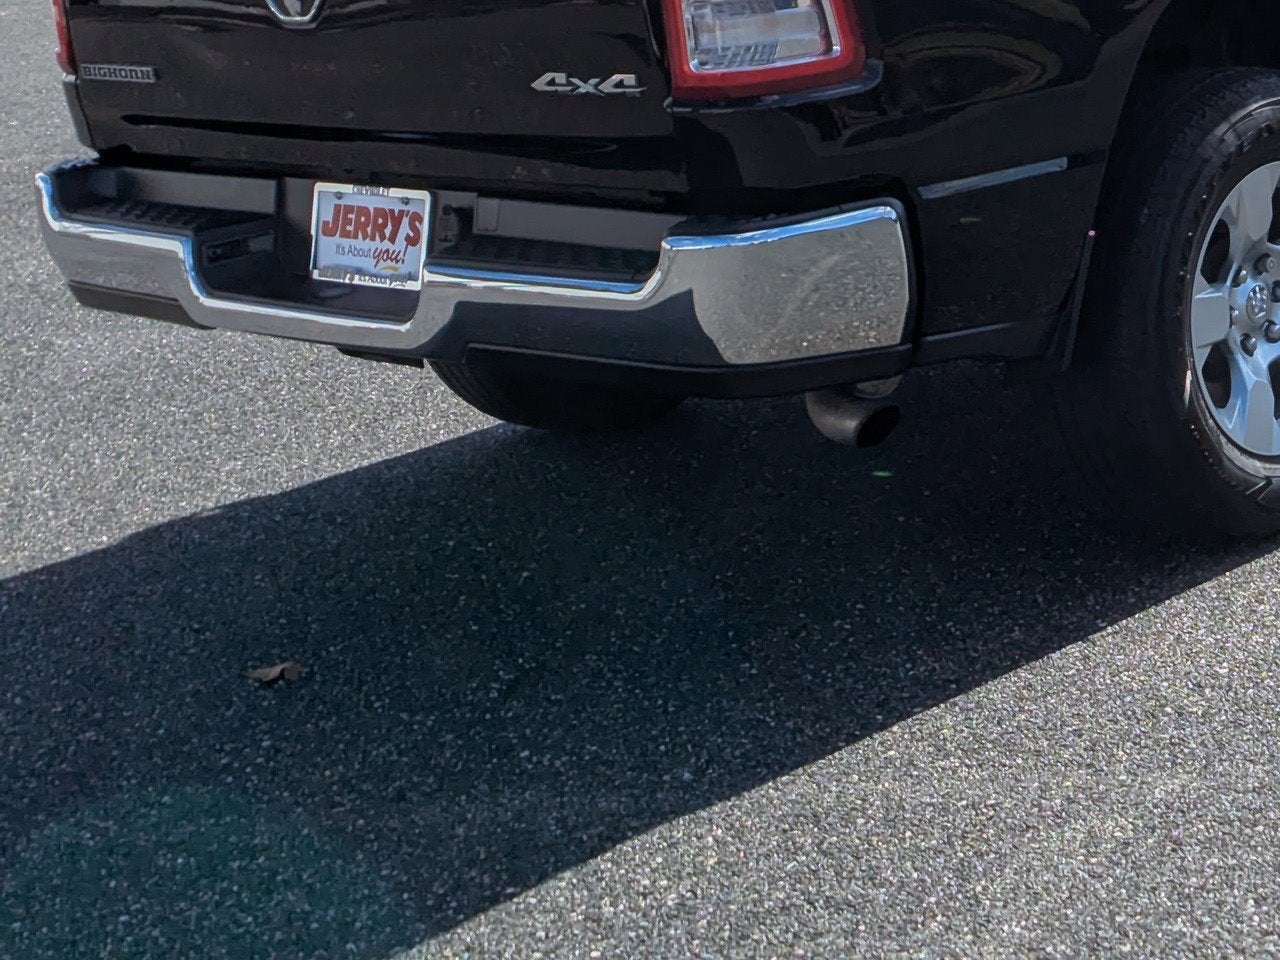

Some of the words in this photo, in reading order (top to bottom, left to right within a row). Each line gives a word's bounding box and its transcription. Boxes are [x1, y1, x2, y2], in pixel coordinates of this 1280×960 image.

[81, 66, 152, 81] BIGHORN
[530, 72, 647, 96] 4x4
[321, 203, 424, 247] JERRY'S
[347, 244, 372, 259] About
[372, 242, 409, 269] you!
